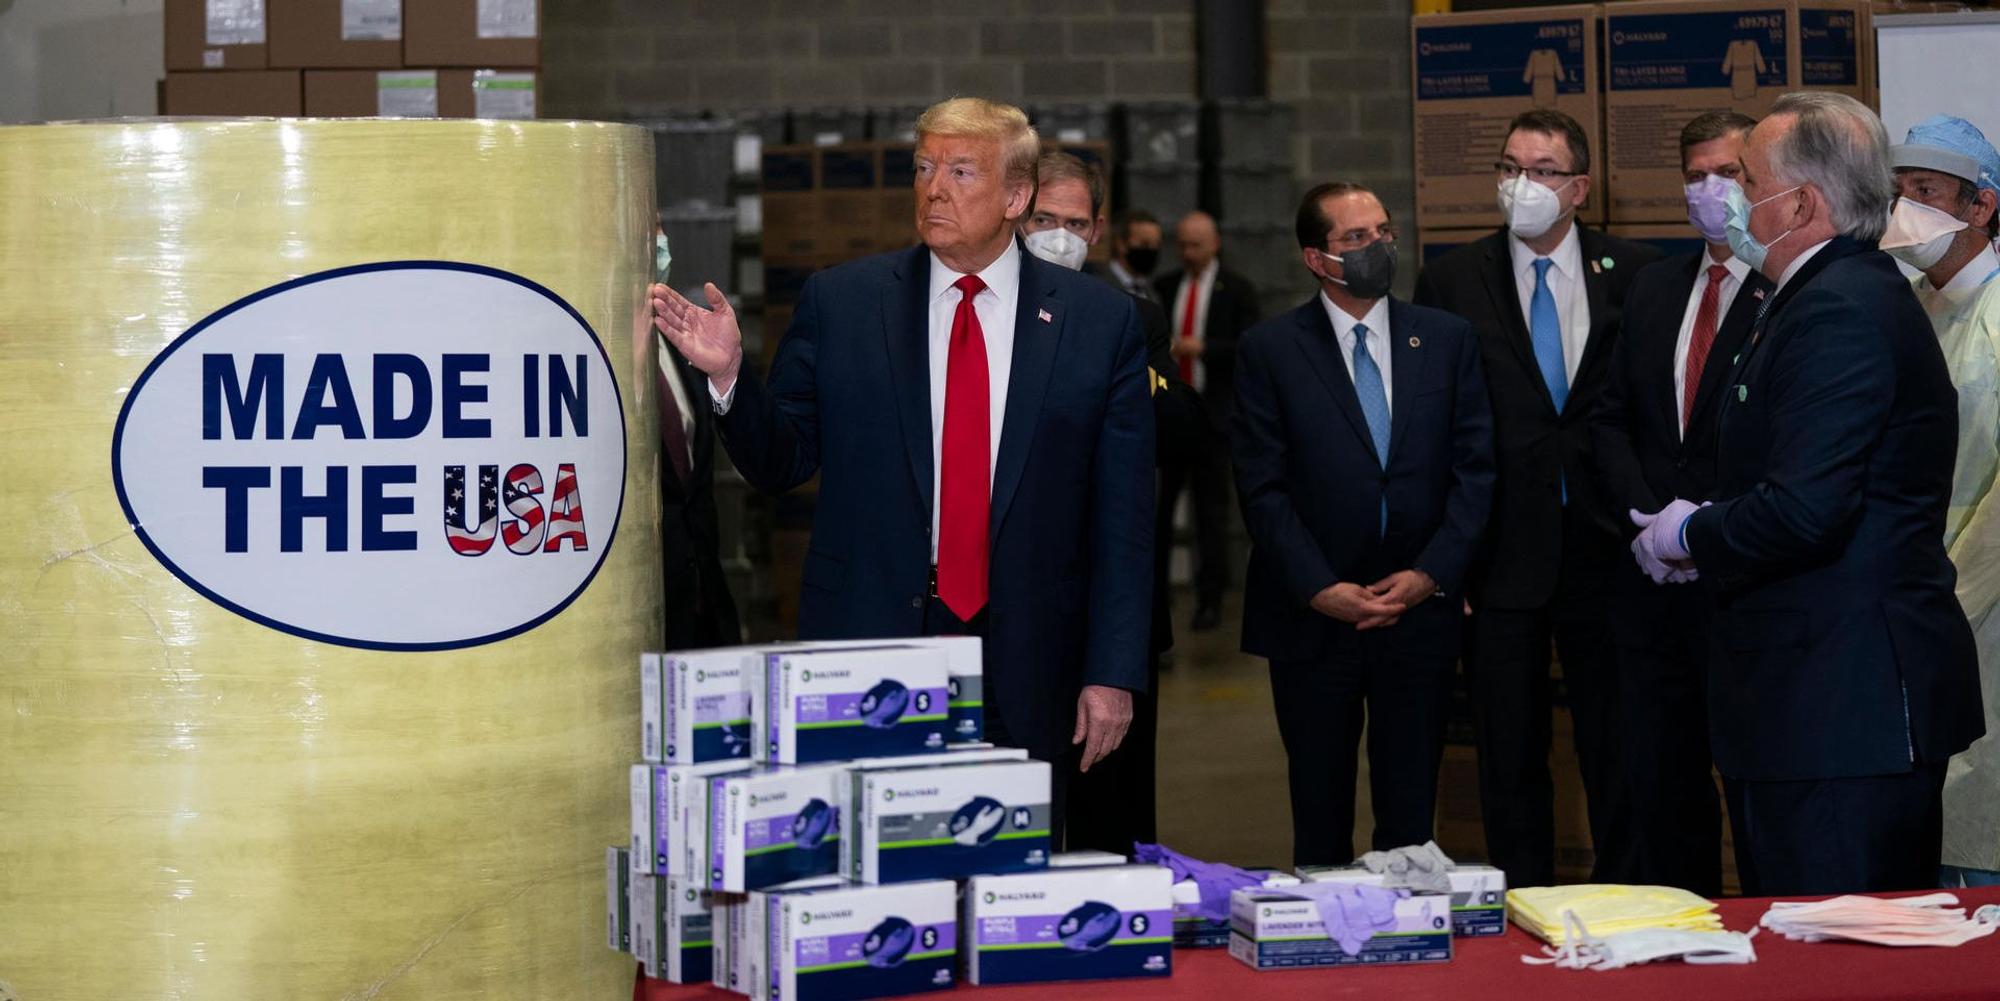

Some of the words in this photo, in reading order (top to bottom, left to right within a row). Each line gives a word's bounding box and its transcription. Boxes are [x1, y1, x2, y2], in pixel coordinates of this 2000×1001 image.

[202, 353, 492, 440] MADE
[523, 354, 589, 438] IN
[202, 465, 418, 553] THE
[443, 463, 589, 557] USA
[918, 693, 929, 710] S
[1015, 811, 1028, 826] M
[998, 892, 1046, 900] HALYARD
[1132, 917, 1145, 932] S
[924, 930, 935, 946] S
